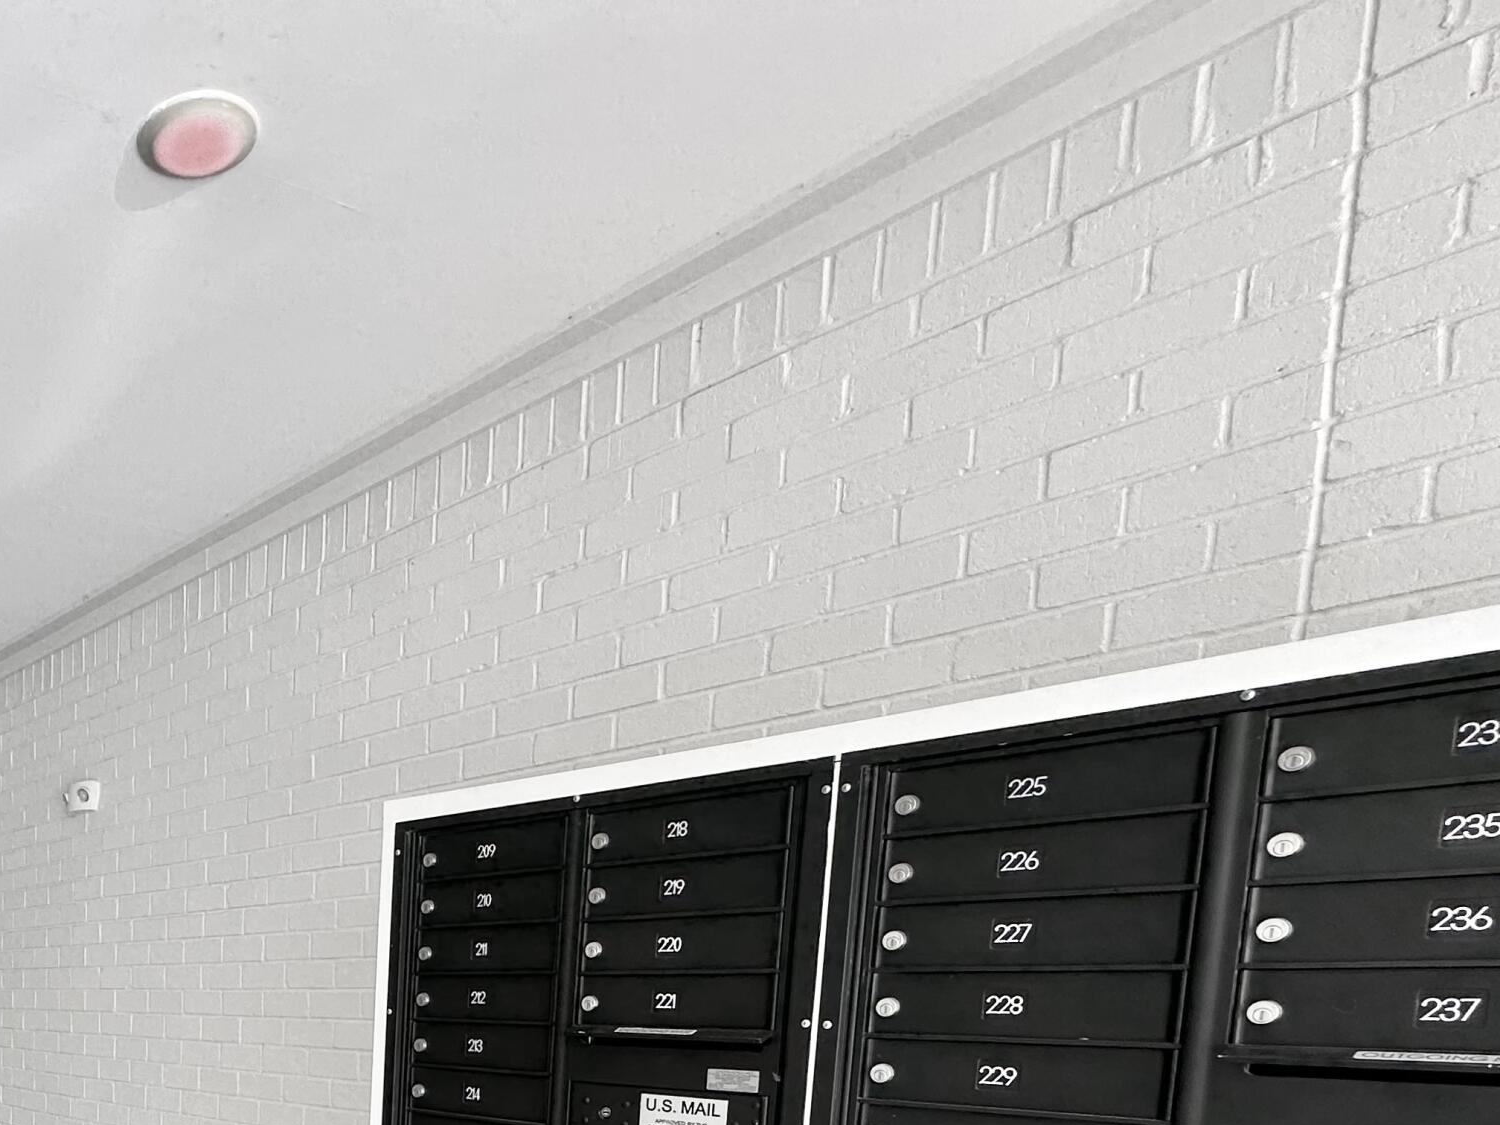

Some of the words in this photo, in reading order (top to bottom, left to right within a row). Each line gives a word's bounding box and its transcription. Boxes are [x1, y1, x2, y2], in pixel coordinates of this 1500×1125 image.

[1456, 719, 1500, 748] 23
[1007, 775, 1049, 800] 225
[667, 820, 689, 839] 218
[1440, 812, 1500, 841] 235
[477, 843, 497, 859] 209
[999, 850, 1040, 872] 226
[663, 878, 686, 896] 219
[476, 893, 493, 908] 210
[1429, 905, 1494, 932] 236
[993, 922, 1033, 944] 227
[475, 942, 488, 957] 211
[657, 936, 683, 953] 220
[470, 990, 487, 1005] 212
[655, 992, 677, 1010] 221
[985, 994, 1024, 1016] 228
[1416, 997, 1483, 1023] 237
[467, 1038, 484, 1053] 213
[978, 1065, 1018, 1087] 229
[465, 1086, 481, 1101] 214
[646, 1097, 677, 1113] U.S.
[680, 1100, 721, 1117] MAIL
